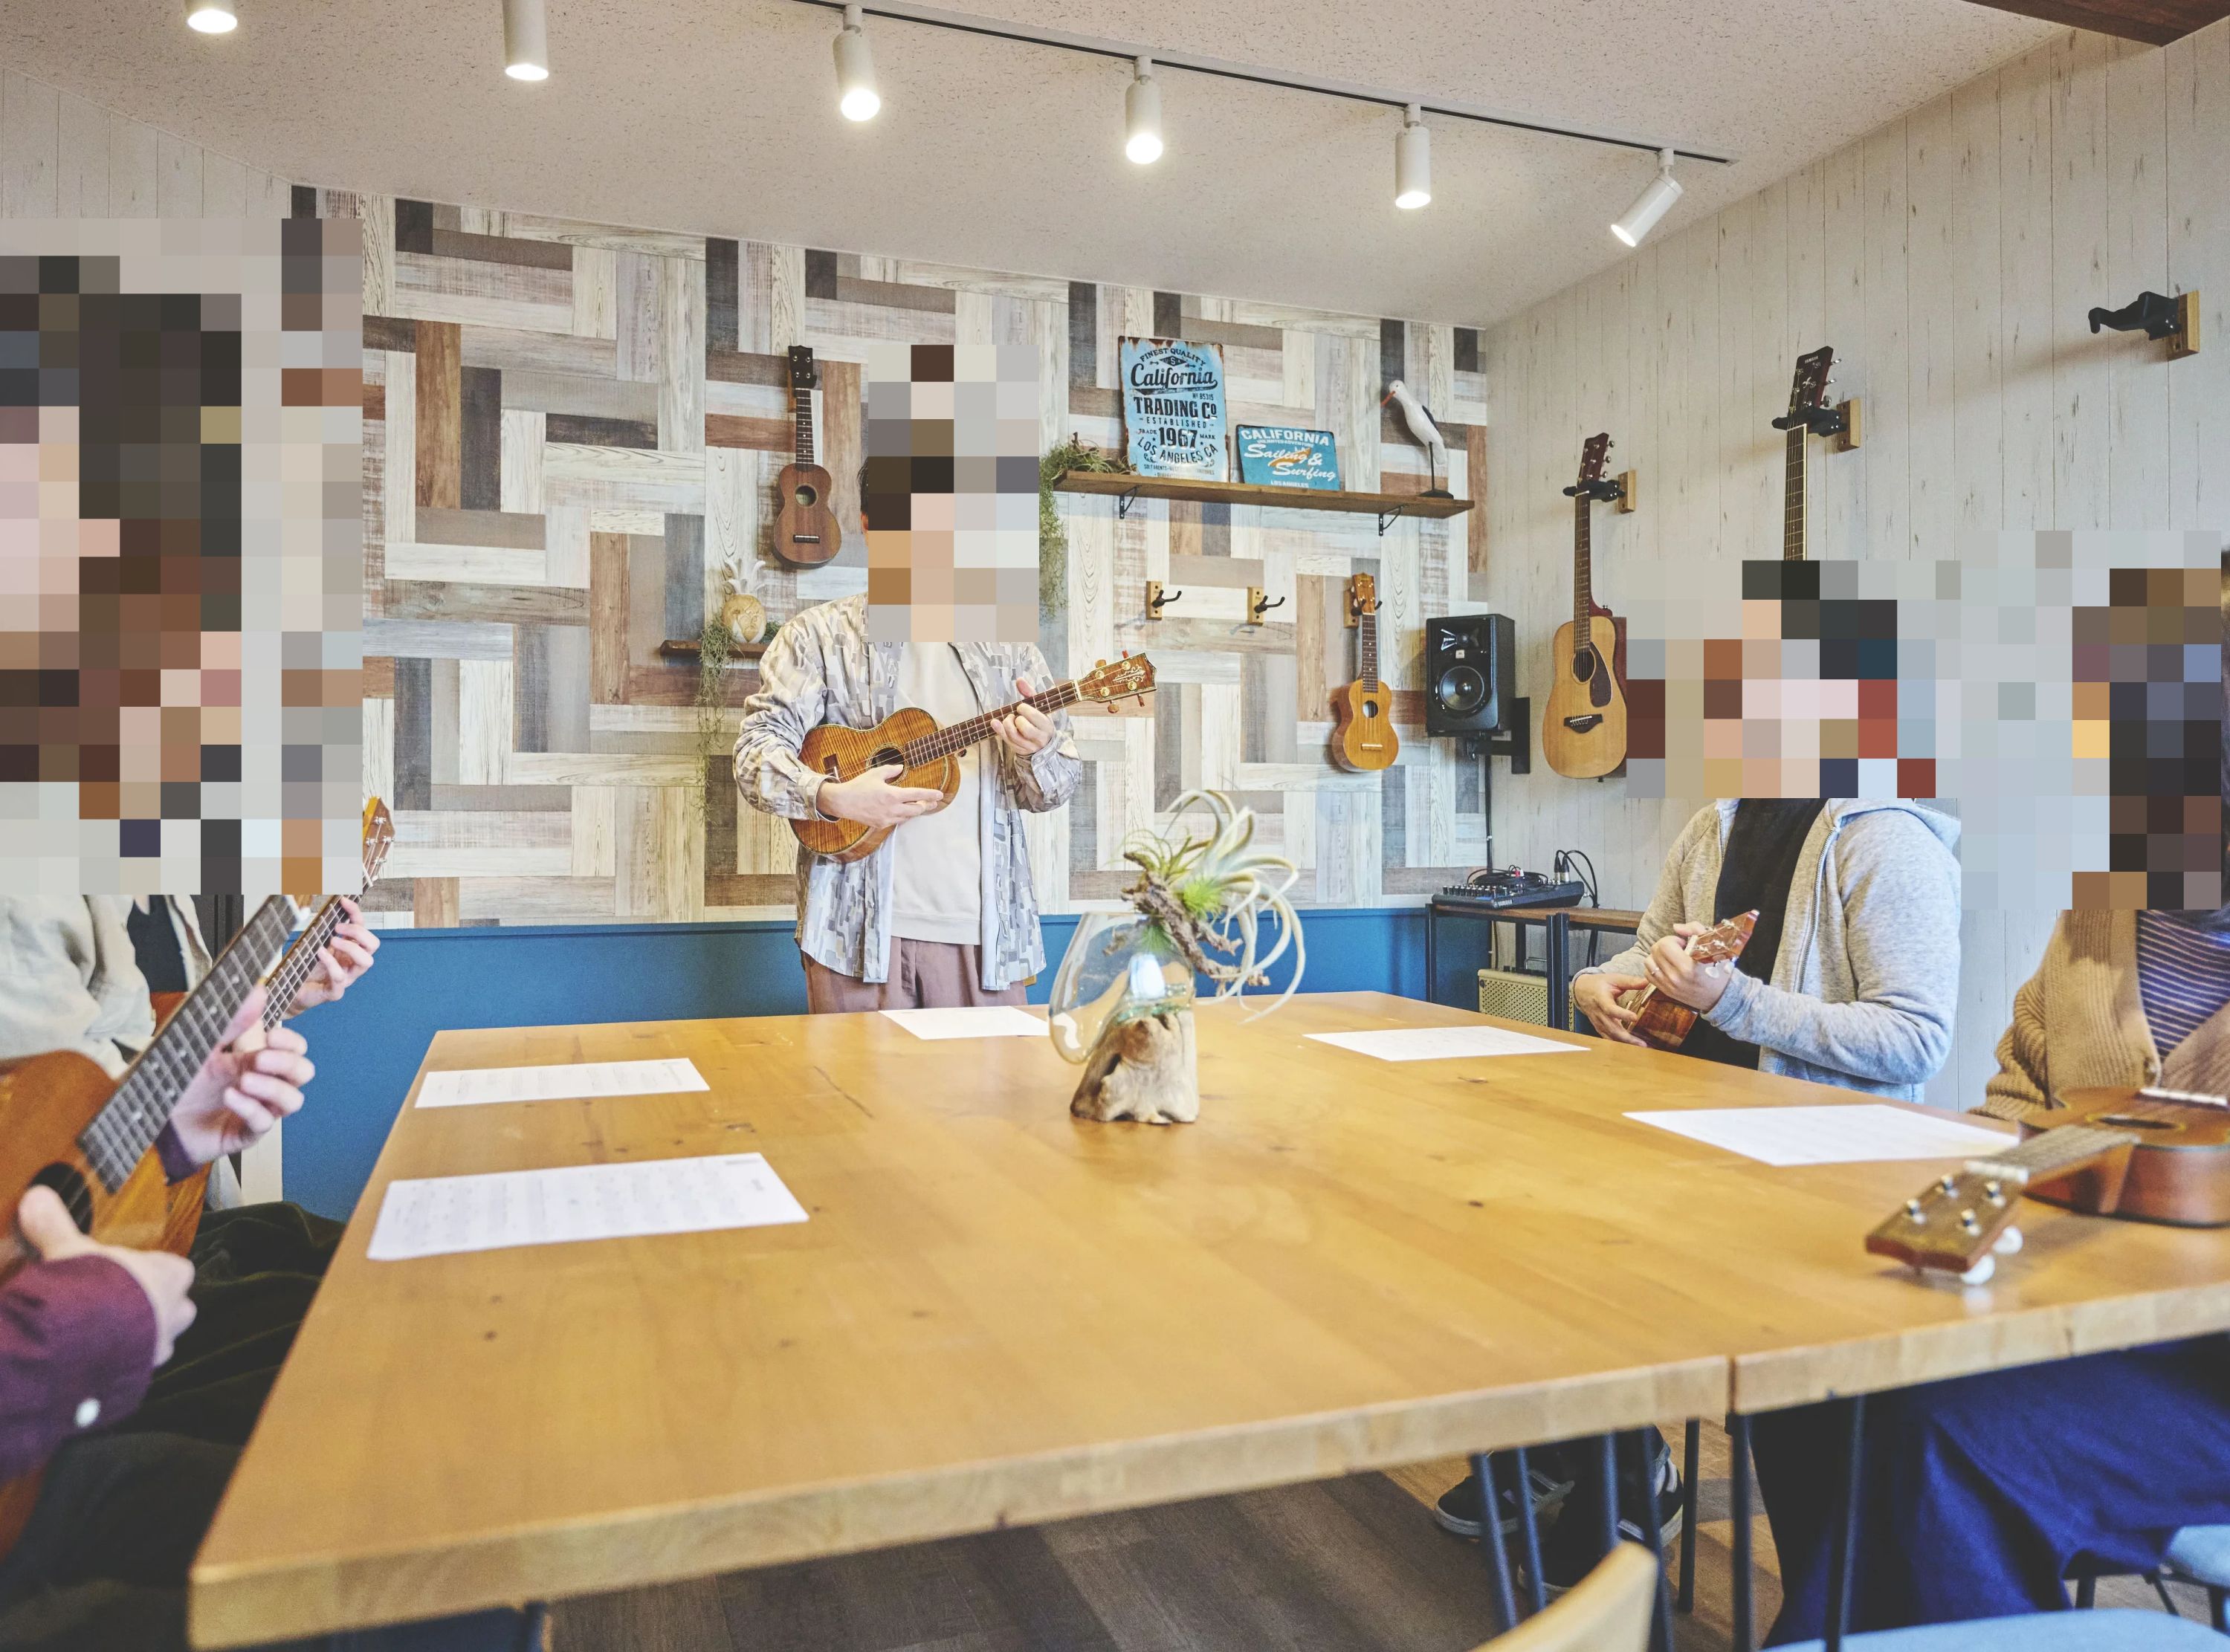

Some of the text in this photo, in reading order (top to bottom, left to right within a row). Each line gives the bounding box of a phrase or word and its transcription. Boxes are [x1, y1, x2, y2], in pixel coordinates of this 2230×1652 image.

[1140, 348, 1206, 366] FINEST QUALITY
[1131, 363, 1218, 389] California
[1133, 396, 1198, 418] TRADING
[1146, 416, 1207, 429] ESTABLISHED
[1159, 427, 1198, 449] 1967
[1241, 429, 1329, 447] CALIFORNIA
[1137, 436, 1218, 464] LOS ANGELES CA
[1244, 444, 1323, 466] Sailing &
[1272, 461, 1337, 482] Surfing
